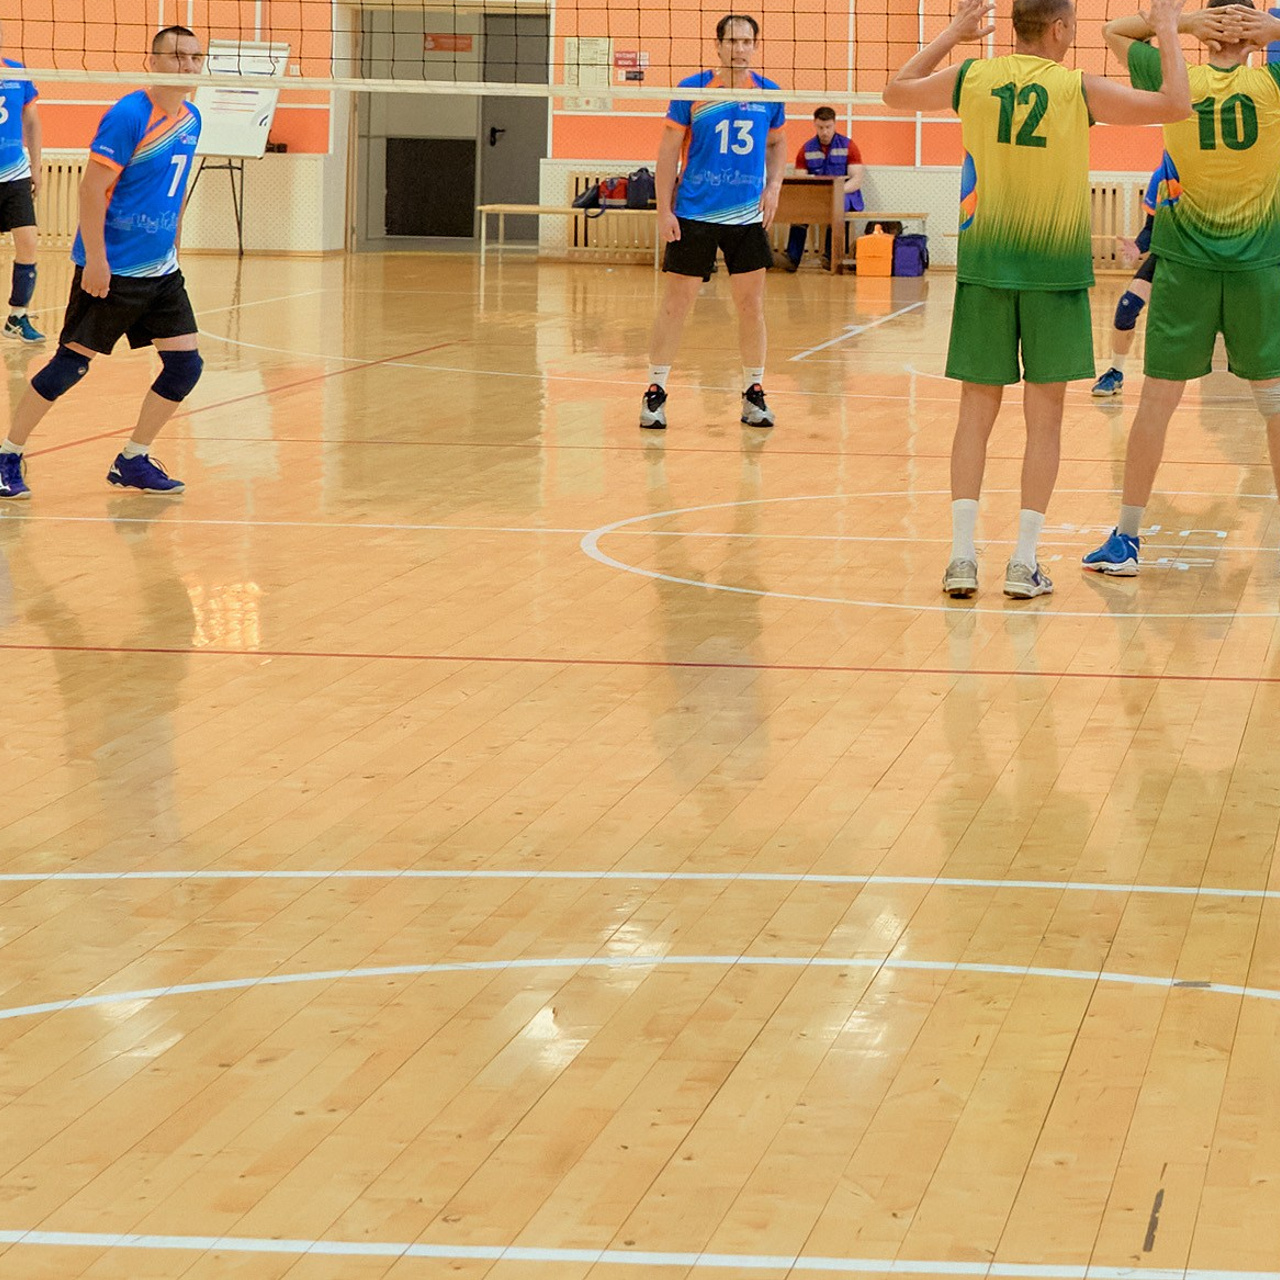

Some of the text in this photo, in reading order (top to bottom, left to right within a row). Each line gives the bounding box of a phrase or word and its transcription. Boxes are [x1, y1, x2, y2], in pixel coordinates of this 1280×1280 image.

[715, 119, 754, 155] 13
[991, 81, 1049, 148] 12
[1192, 93, 1259, 151] 10
